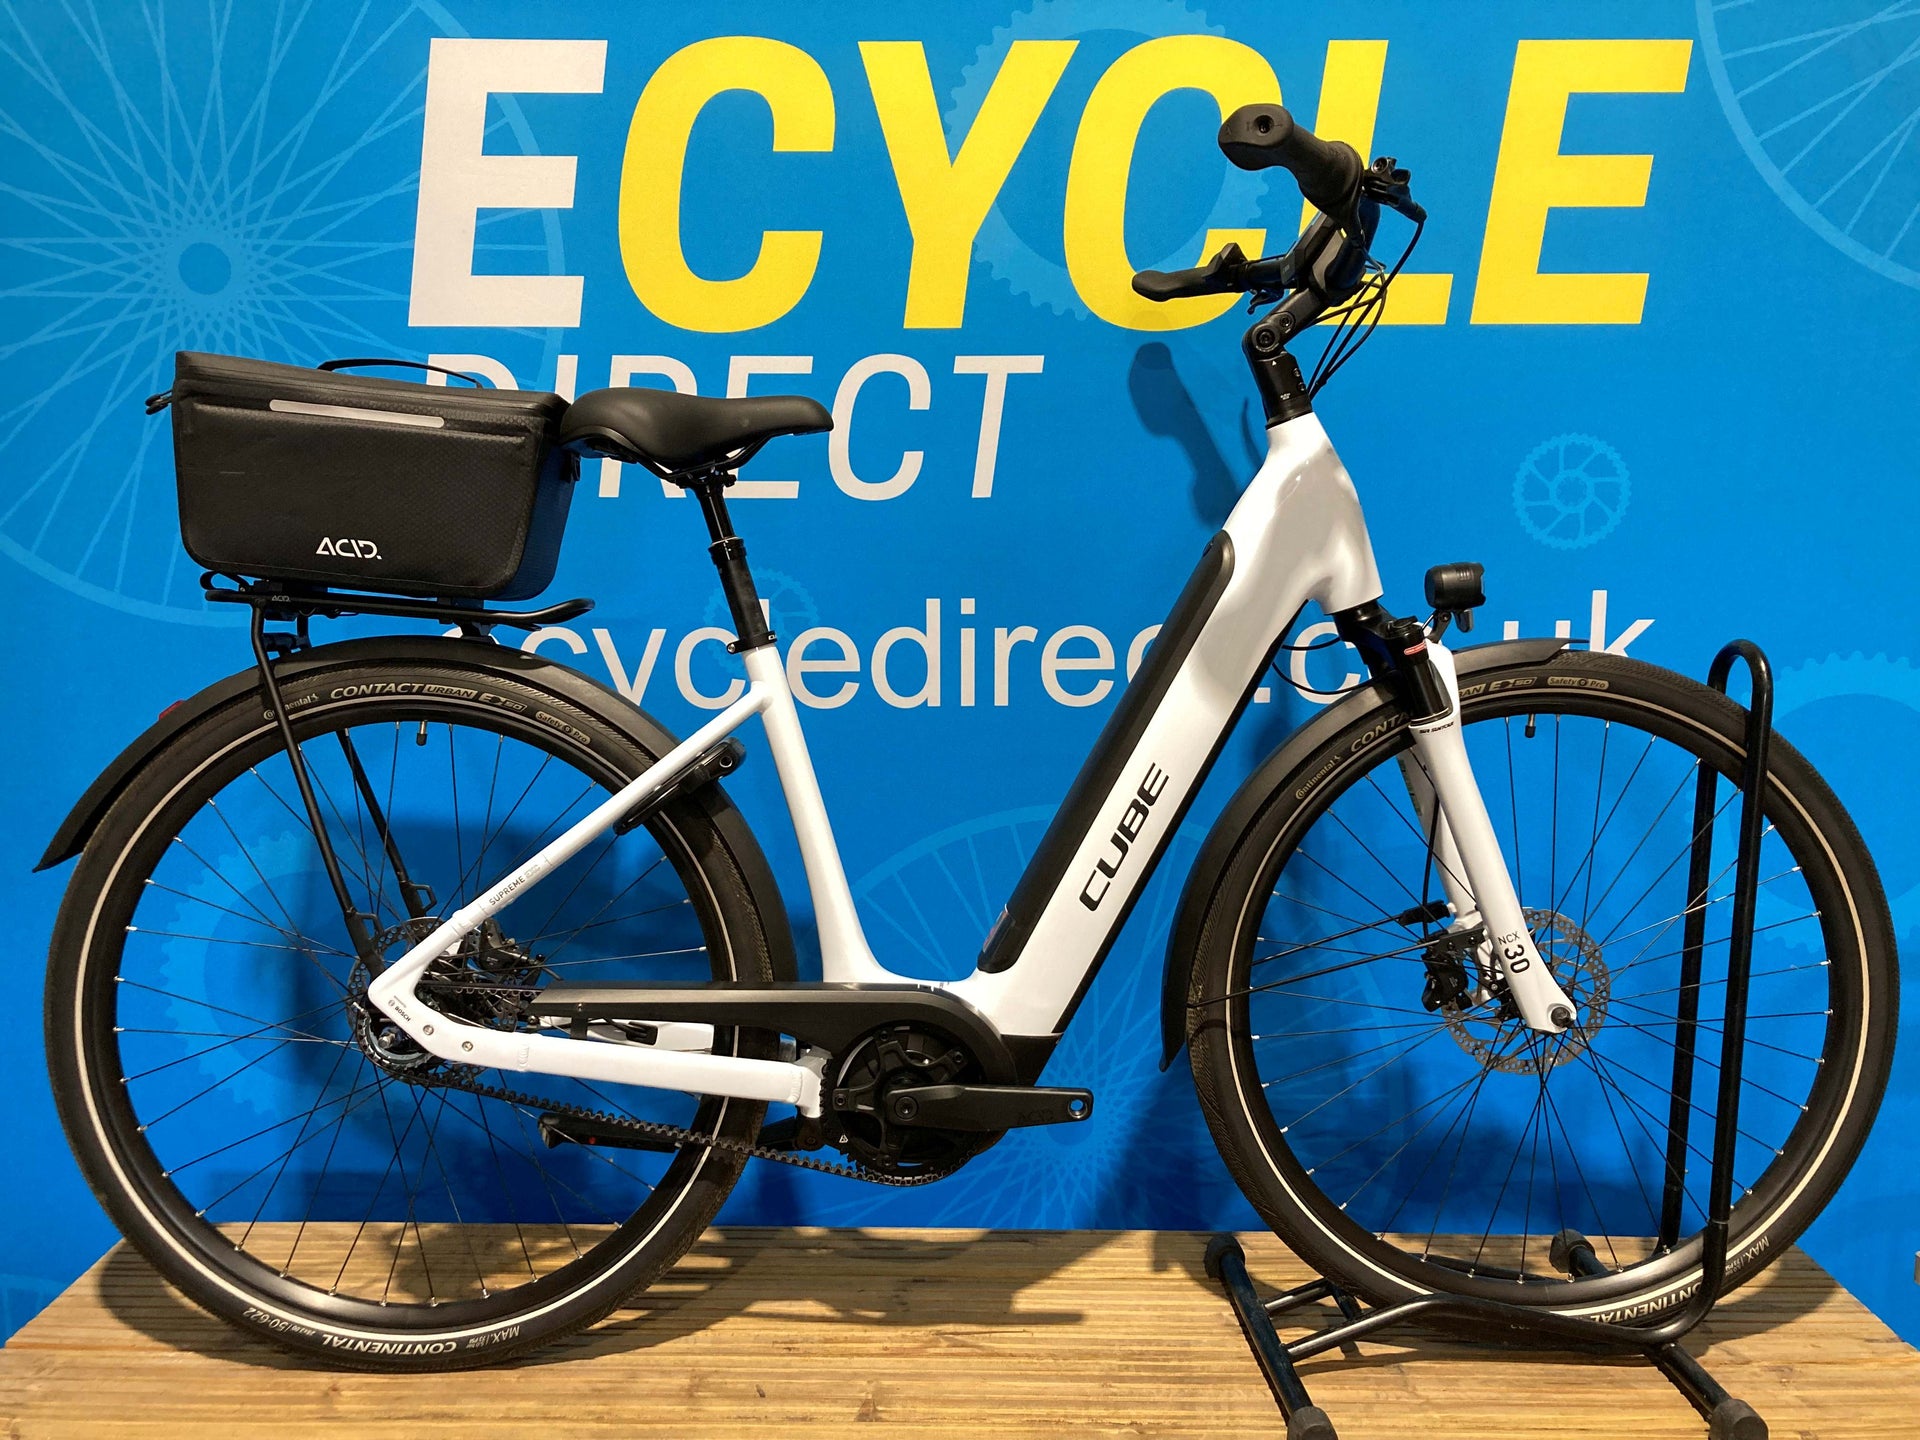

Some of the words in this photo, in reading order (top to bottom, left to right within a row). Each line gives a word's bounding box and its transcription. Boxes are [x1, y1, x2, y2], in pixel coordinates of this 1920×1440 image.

[408, 35, 1693, 333] ECYCLE
[330, 682, 426, 701] CONTACT
[426, 684, 475, 699] URBAN
[1550, 677, 1577, 688] Safety
[1590, 680, 1606, 690] Pro
[538, 712, 563, 729] Safety
[573, 730, 588, 743] Pro
[1295, 759, 1336, 801] Continental
[1079, 762, 1169, 912] CUBE
[488, 875, 526, 906] SUPREME
[1497, 931, 1520, 946] NCX
[1504, 944, 1531, 974] 30
[394, 1005, 412, 1022] BOSCH
[321, 1333, 457, 1355] CONTINENTAL
